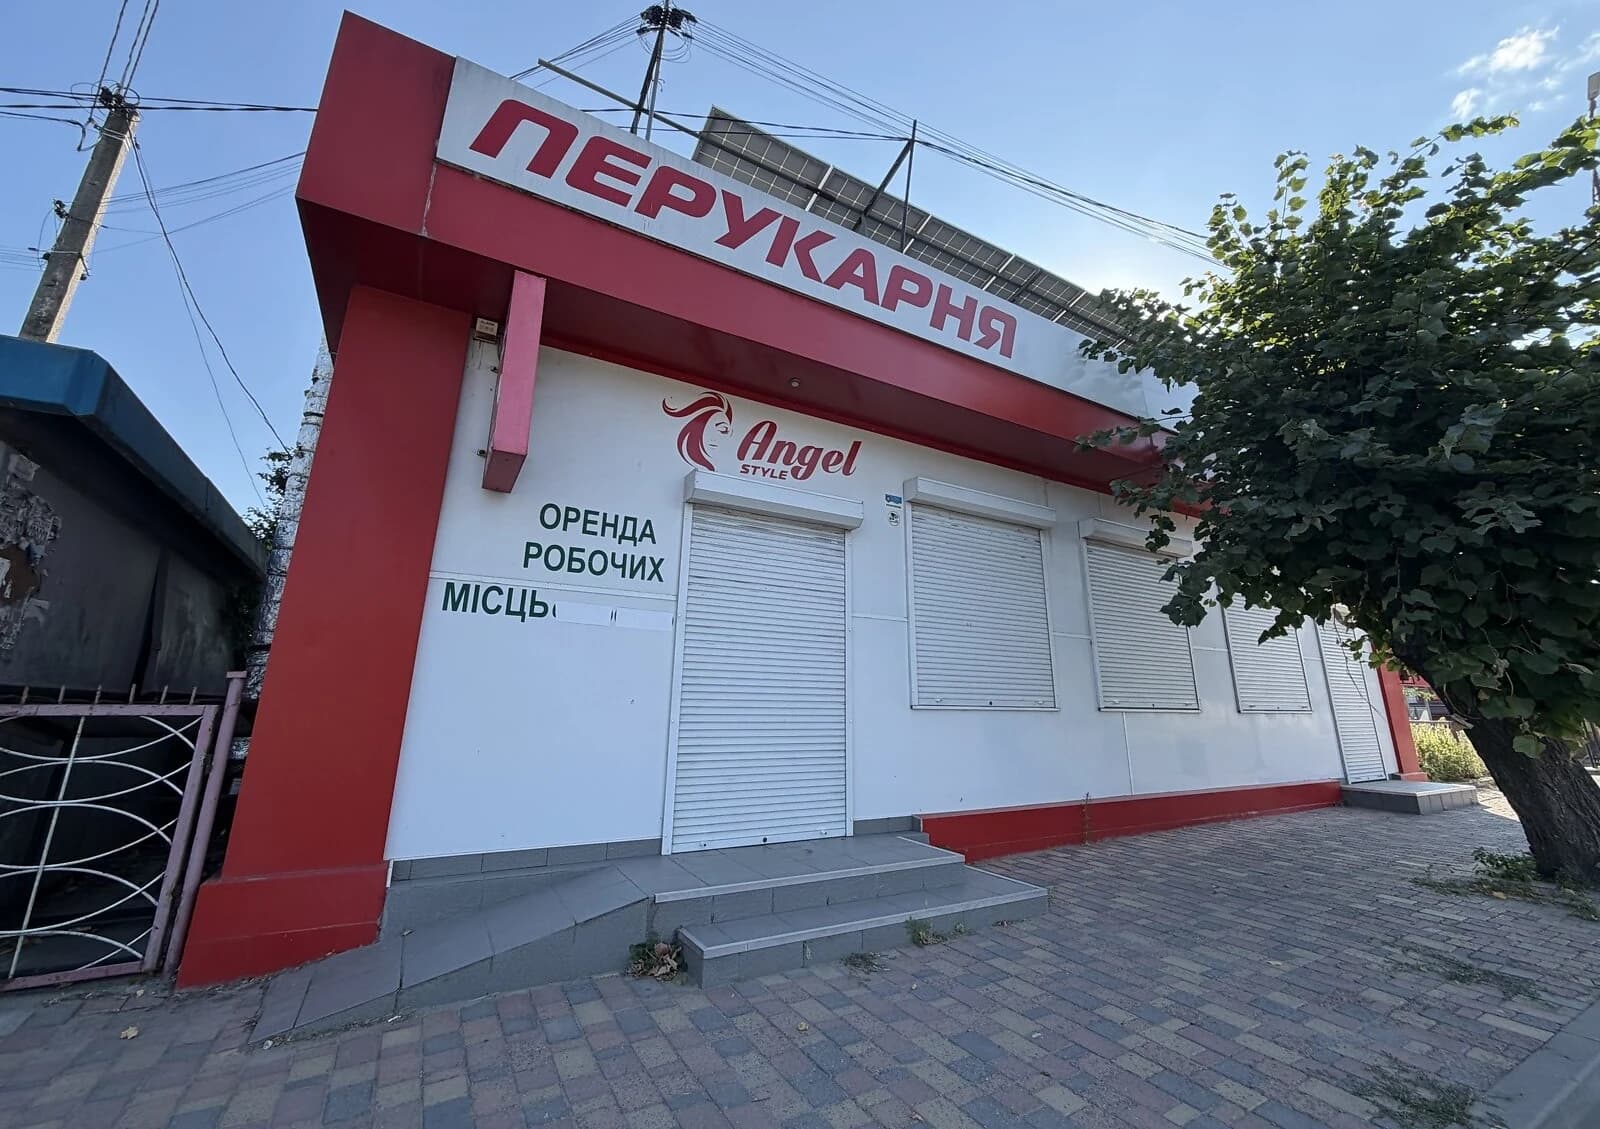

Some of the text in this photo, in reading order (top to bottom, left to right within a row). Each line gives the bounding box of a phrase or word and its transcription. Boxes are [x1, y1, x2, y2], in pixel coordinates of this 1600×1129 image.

[470, 99, 1017, 358] ПЕРУКАРНЯ
[737, 420, 862, 480] Angel
[740, 464, 788, 480] STYLE
[540, 503, 657, 546] ОРЕНДА
[523, 542, 665, 583] РОБОЧИХ
[442, 581, 549, 622] МІСЦЬ
